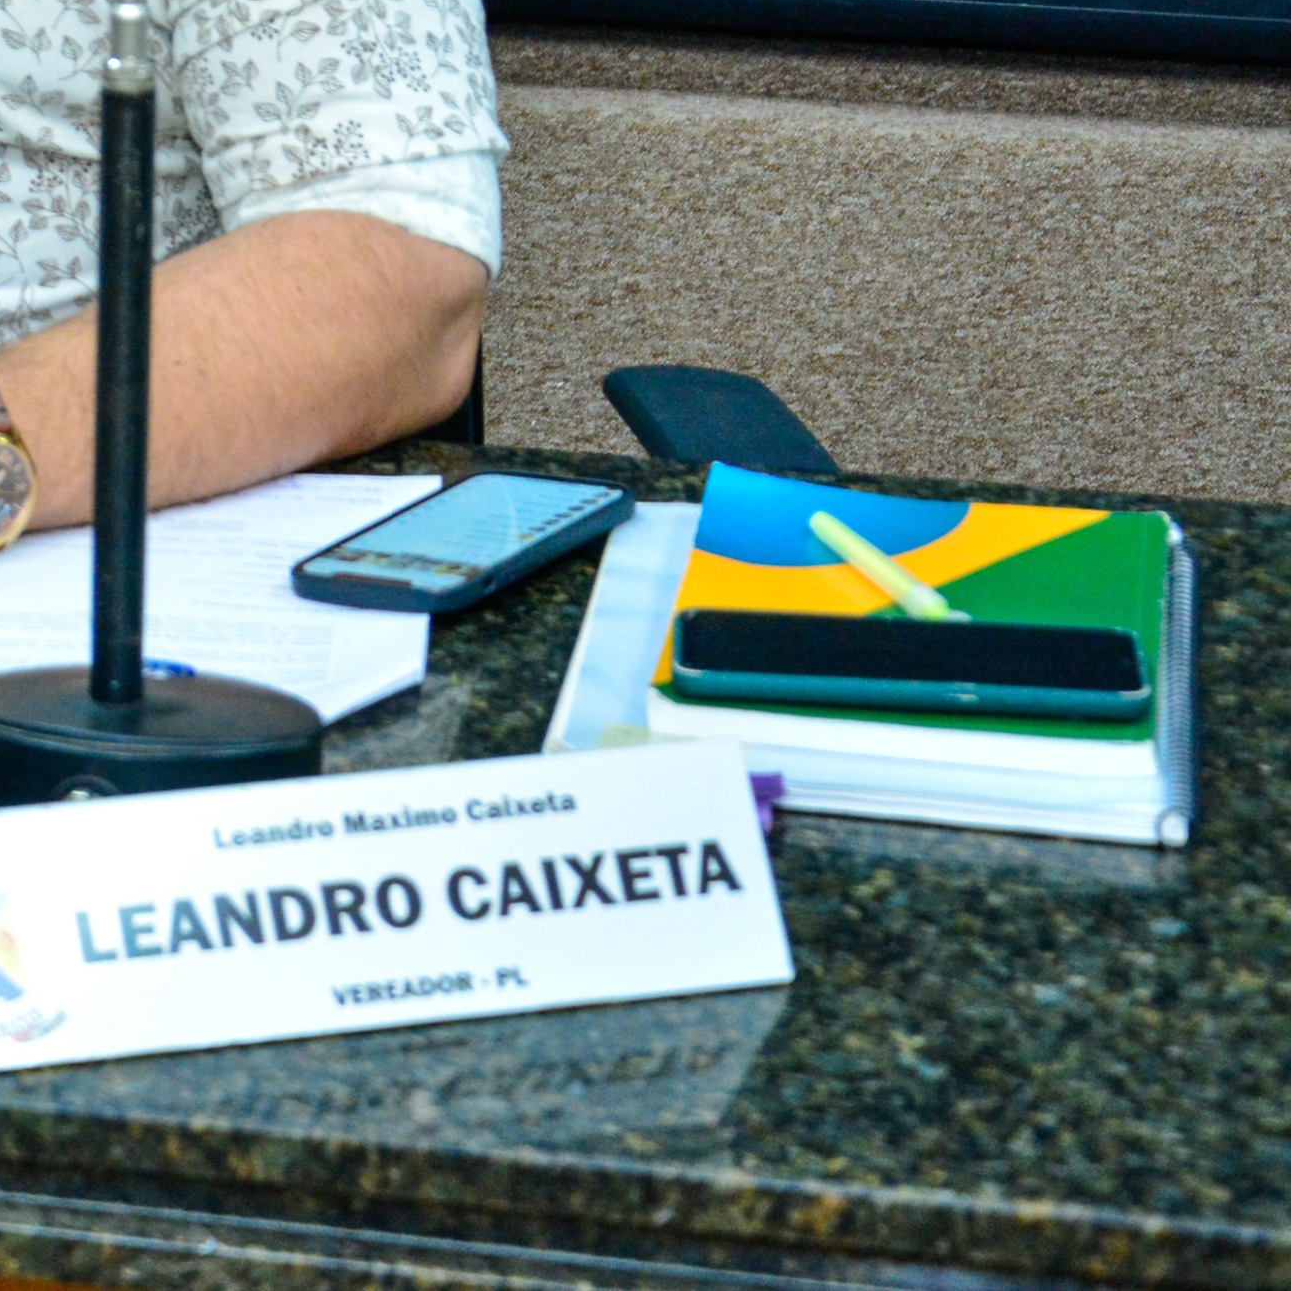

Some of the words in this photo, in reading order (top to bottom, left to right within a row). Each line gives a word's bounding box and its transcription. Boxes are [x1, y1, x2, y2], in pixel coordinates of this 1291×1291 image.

[215, 819, 333, 848] Leandro
[343, 807, 457, 835] Maximo
[465, 795, 576, 821] Caixeta
[76, 875, 420, 964] LEANDRO
[447, 840, 742, 920] CAIXETA
[331, 973, 472, 1007] VEREADOR
[495, 967, 529, 988] PL
